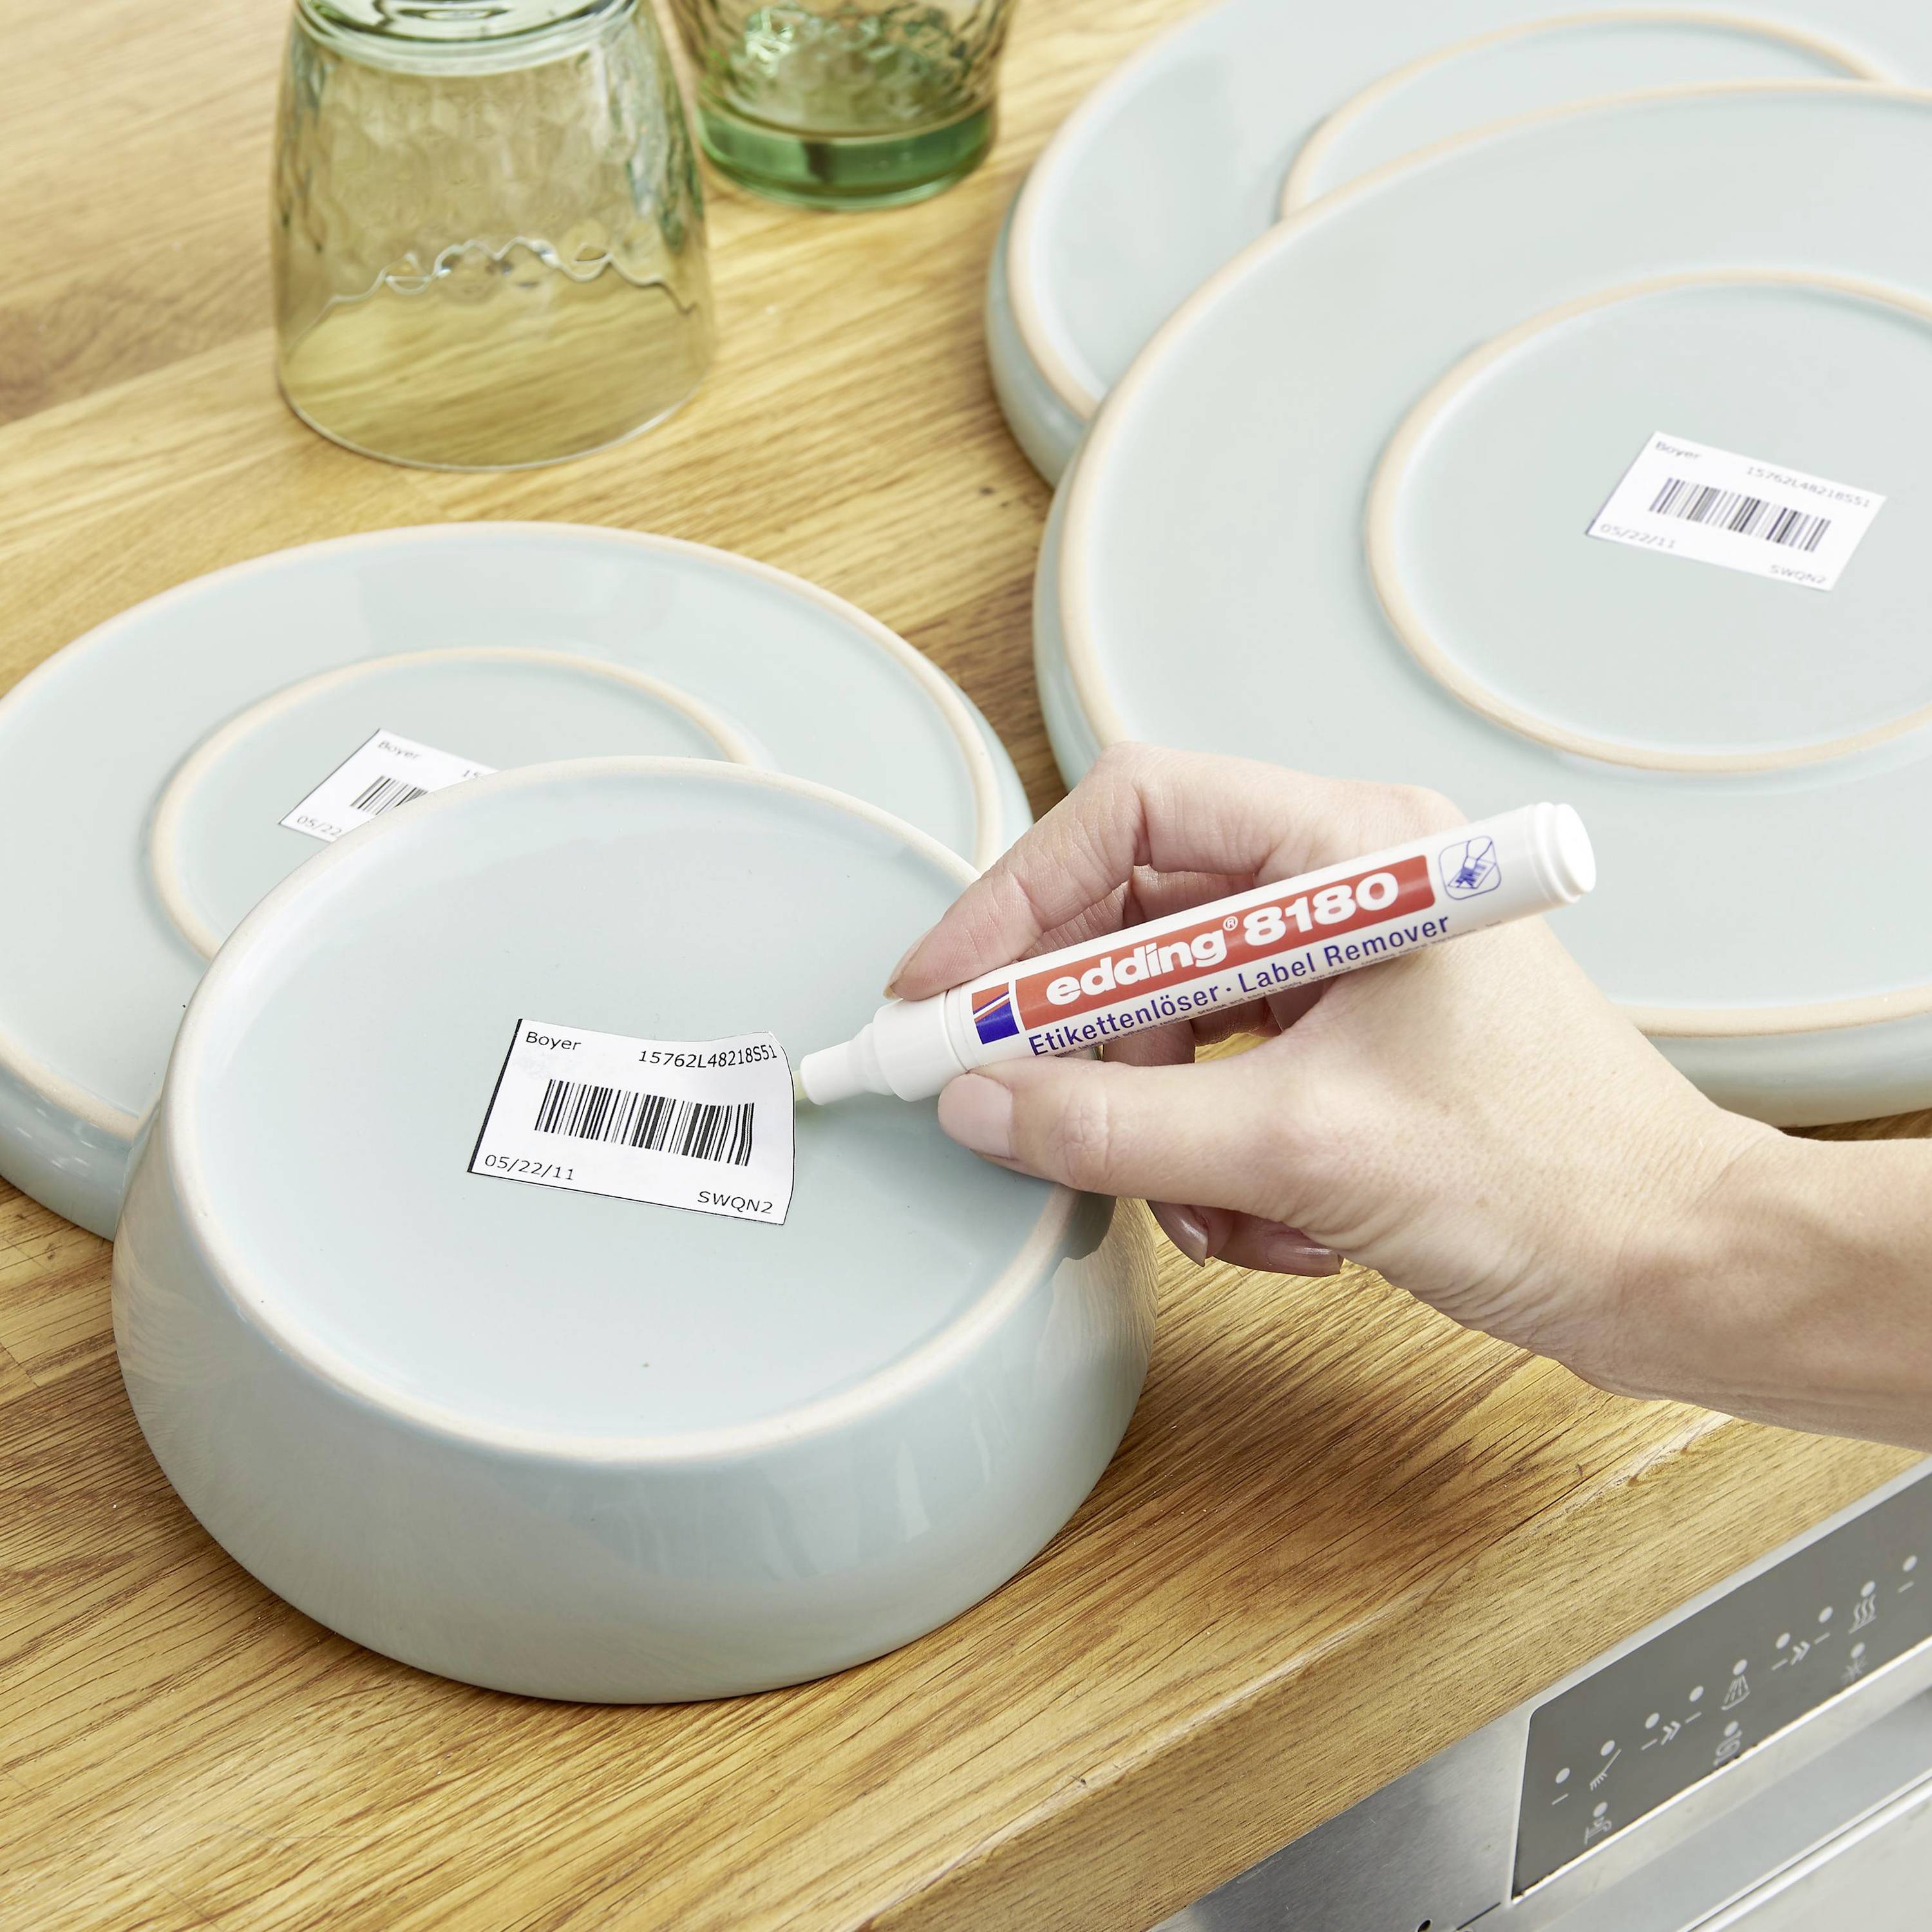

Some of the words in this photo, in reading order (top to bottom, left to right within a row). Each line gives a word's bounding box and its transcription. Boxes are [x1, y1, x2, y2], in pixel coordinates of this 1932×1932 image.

[1655, 441, 1702, 460] Boyer
[1600, 522, 1676, 549] 05/22/11
[1769, 564, 1827, 584] SWQN2
[378, 741, 421, 759] Boyer
[296, 815, 343, 837] 05/22
[1243, 872, 1399, 947] 8180
[1028, 986, 1218, 1056] Etikettenlöser
[1238, 952, 1316, 993] Label
[1323, 916, 1449, 967] Remover
[525, 1030, 582, 1051] Boyer
[638, 1044, 778, 1068] 15762L48218S51
[484, 1154, 574, 1180] 05/22/11
[697, 1191, 773, 1214] SWQN2
